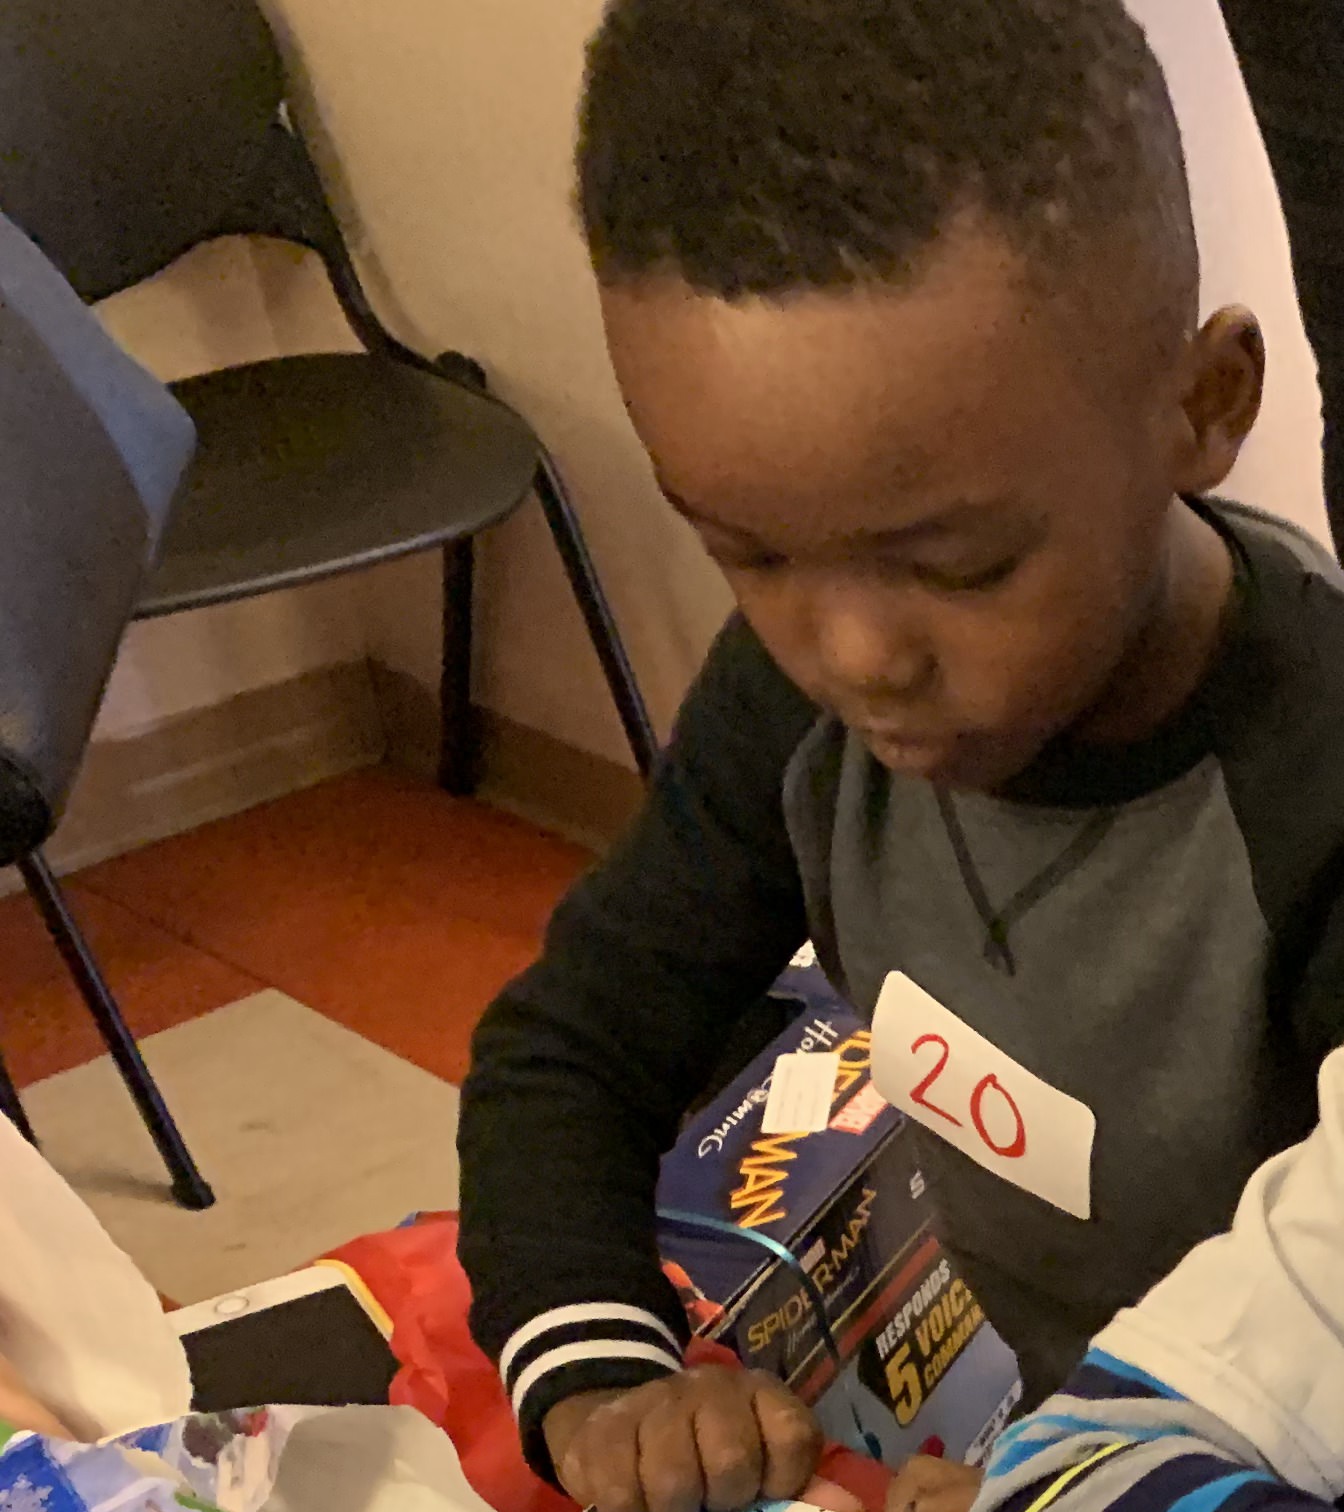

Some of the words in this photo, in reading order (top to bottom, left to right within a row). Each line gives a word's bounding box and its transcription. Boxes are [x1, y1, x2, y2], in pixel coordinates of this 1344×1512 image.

[910, 1033, 1027, 1158] 20
[877, 1258, 953, 1359] RESPONDS
[885, 1342, 924, 1428] 5
